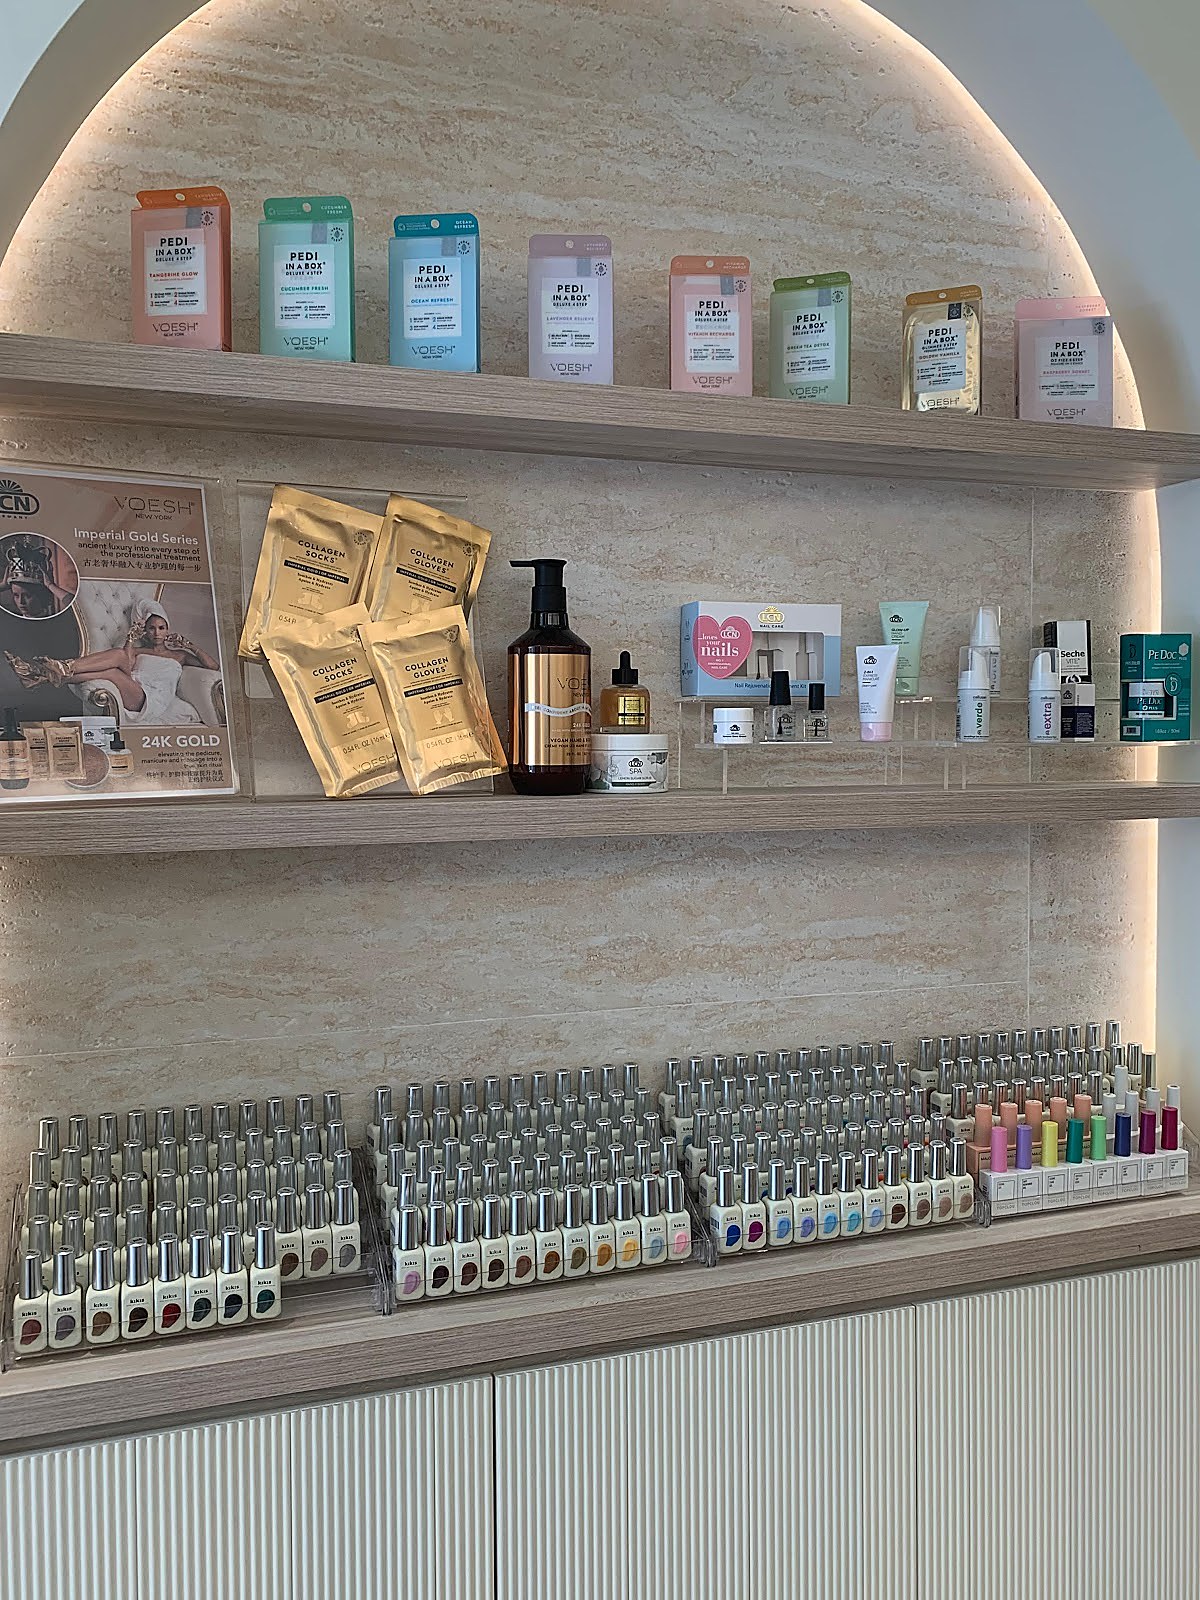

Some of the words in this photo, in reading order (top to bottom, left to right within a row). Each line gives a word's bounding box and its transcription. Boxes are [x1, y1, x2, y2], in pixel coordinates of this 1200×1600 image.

[160, 237, 188, 247] PEDI
[290, 252, 318, 261] PEDI
[419, 265, 446, 274] PEDI
[558, 285, 583, 293] PEDI
[797, 313, 821, 323] PEDI
[928, 327, 952, 337] PEDI
[1056, 342, 1079, 350] PEDI
[0, 495, 30, 511] CN
[74, 528, 124, 541] Imperial
[129, 531, 158, 543] Gold
[162, 534, 198, 545] Series
[78, 542, 107, 550] ancient
[109, 544, 132, 553] luxury
[152, 546, 171, 554] every
[174, 547, 189, 555] step
[298, 540, 345, 558] COLLAGEN
[116, 551, 162, 560] professional
[410, 549, 454, 568] COLLAGEN
[762, 613, 780, 621] LCN
[701, 643, 739, 656] nails
[313, 658, 357, 676] COLLAGEN
[405, 657, 448, 671] COLLAGEN
[975, 702, 983, 728] verde
[1043, 703, 1051, 729] extra
[142, 736, 172, 748] 24K
[176, 735, 220, 747] GOLD
